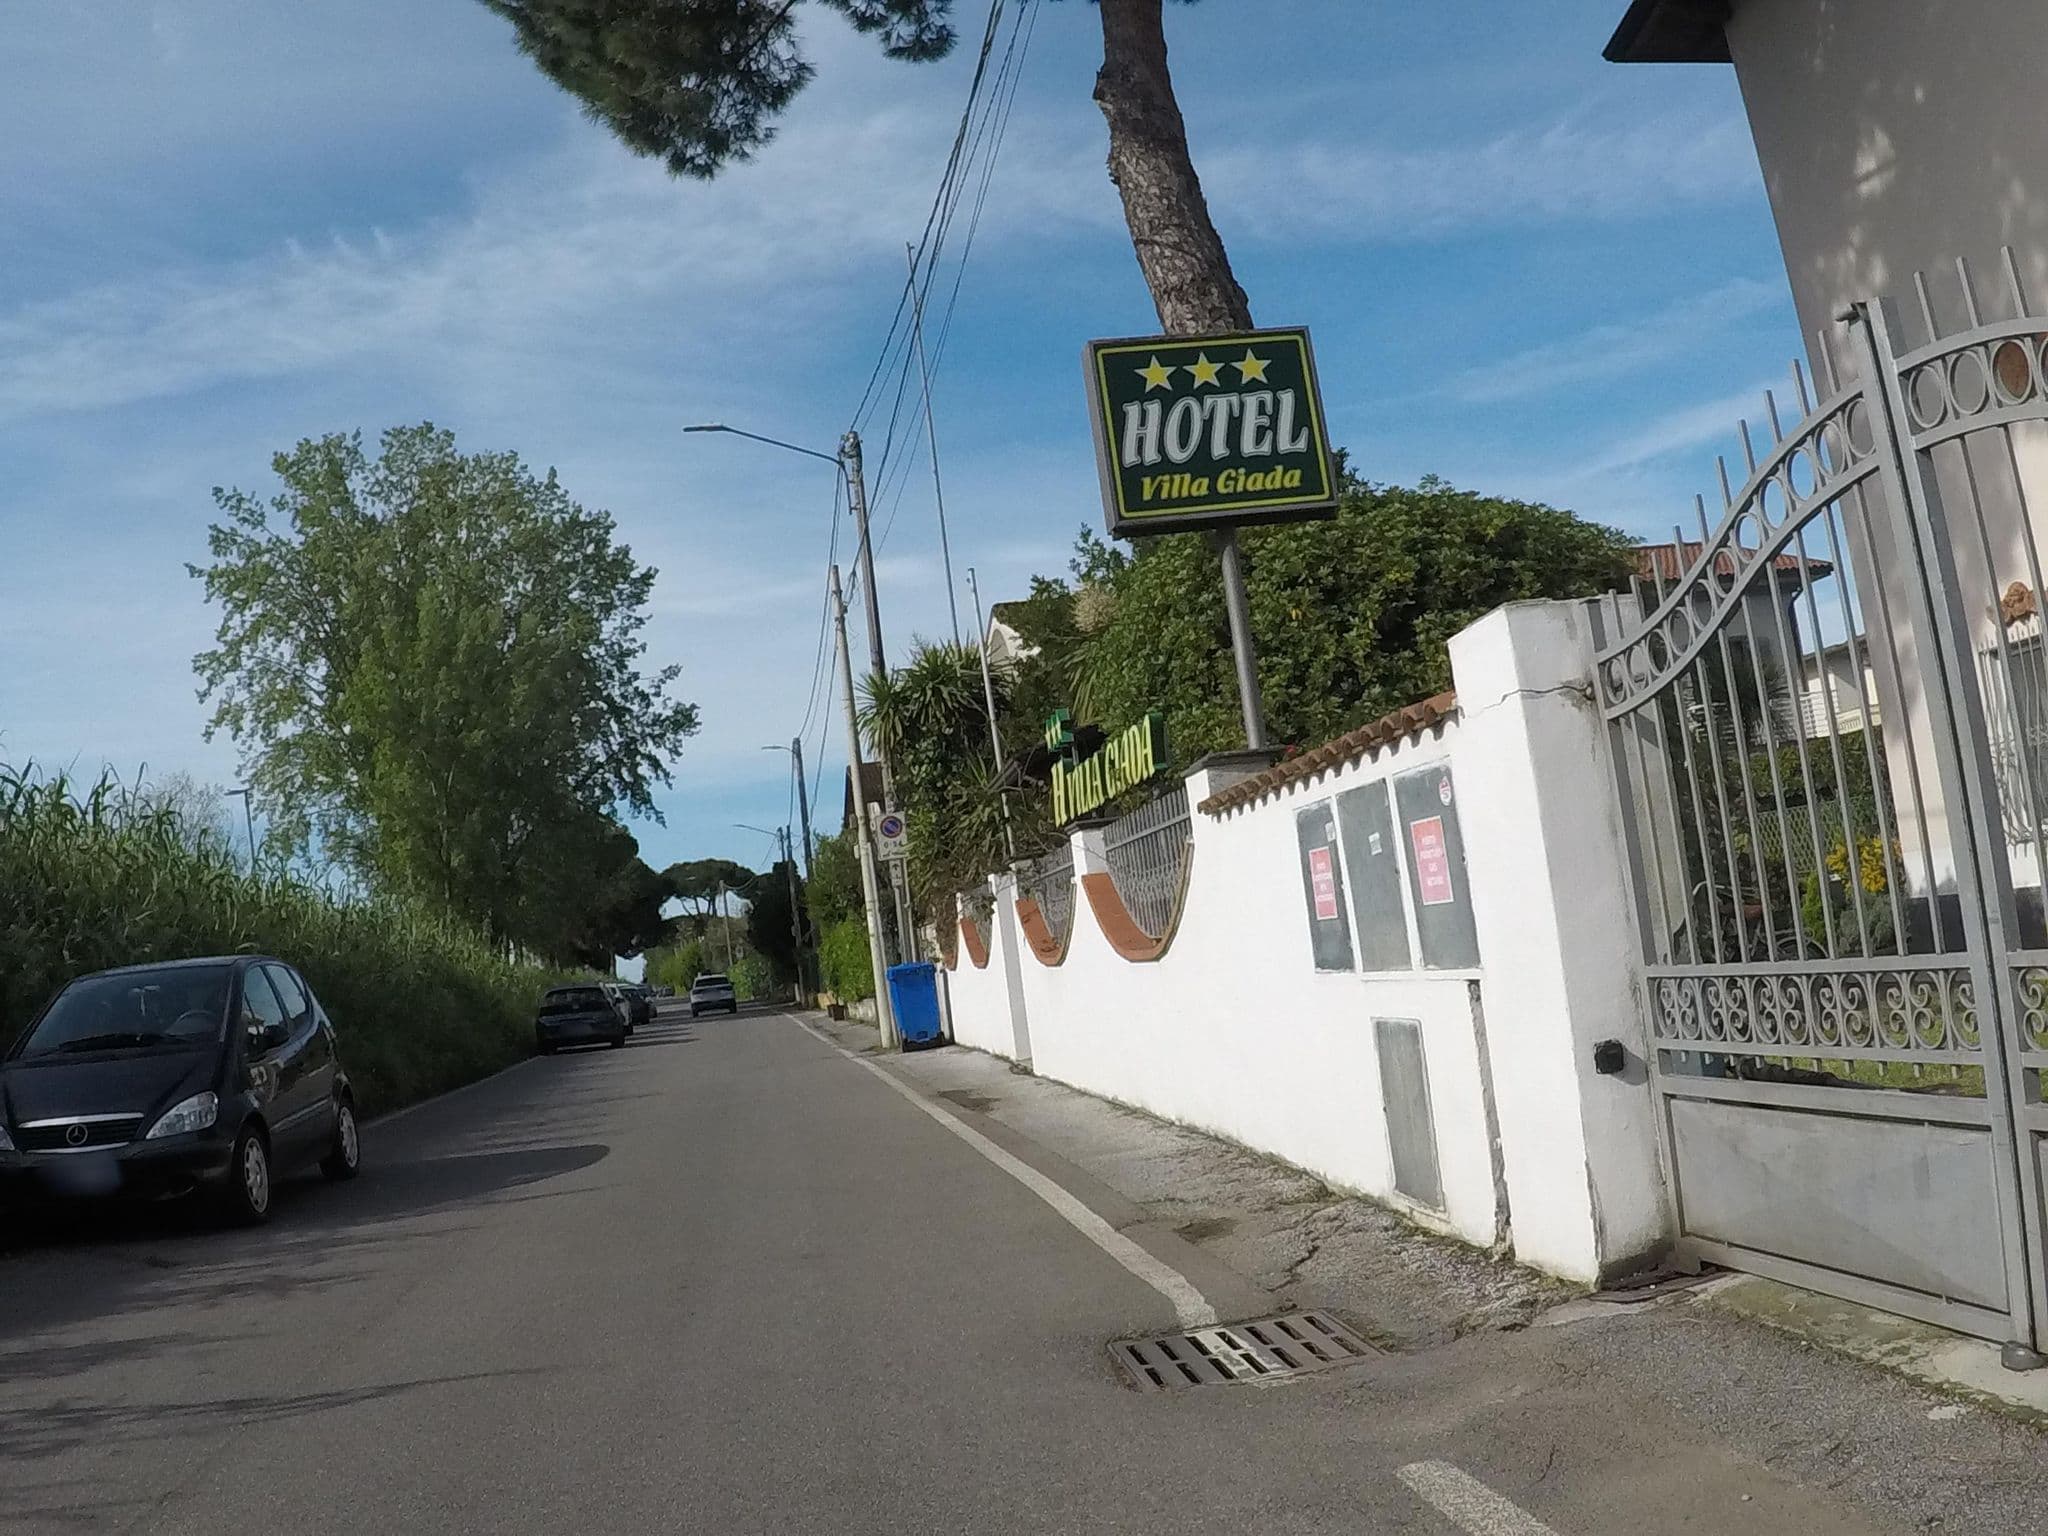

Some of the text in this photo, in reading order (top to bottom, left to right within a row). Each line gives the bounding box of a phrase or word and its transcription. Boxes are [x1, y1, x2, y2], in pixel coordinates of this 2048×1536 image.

[1121, 388, 1309, 468] HOTEL
[1141, 465, 1302, 501] Villa Giada
